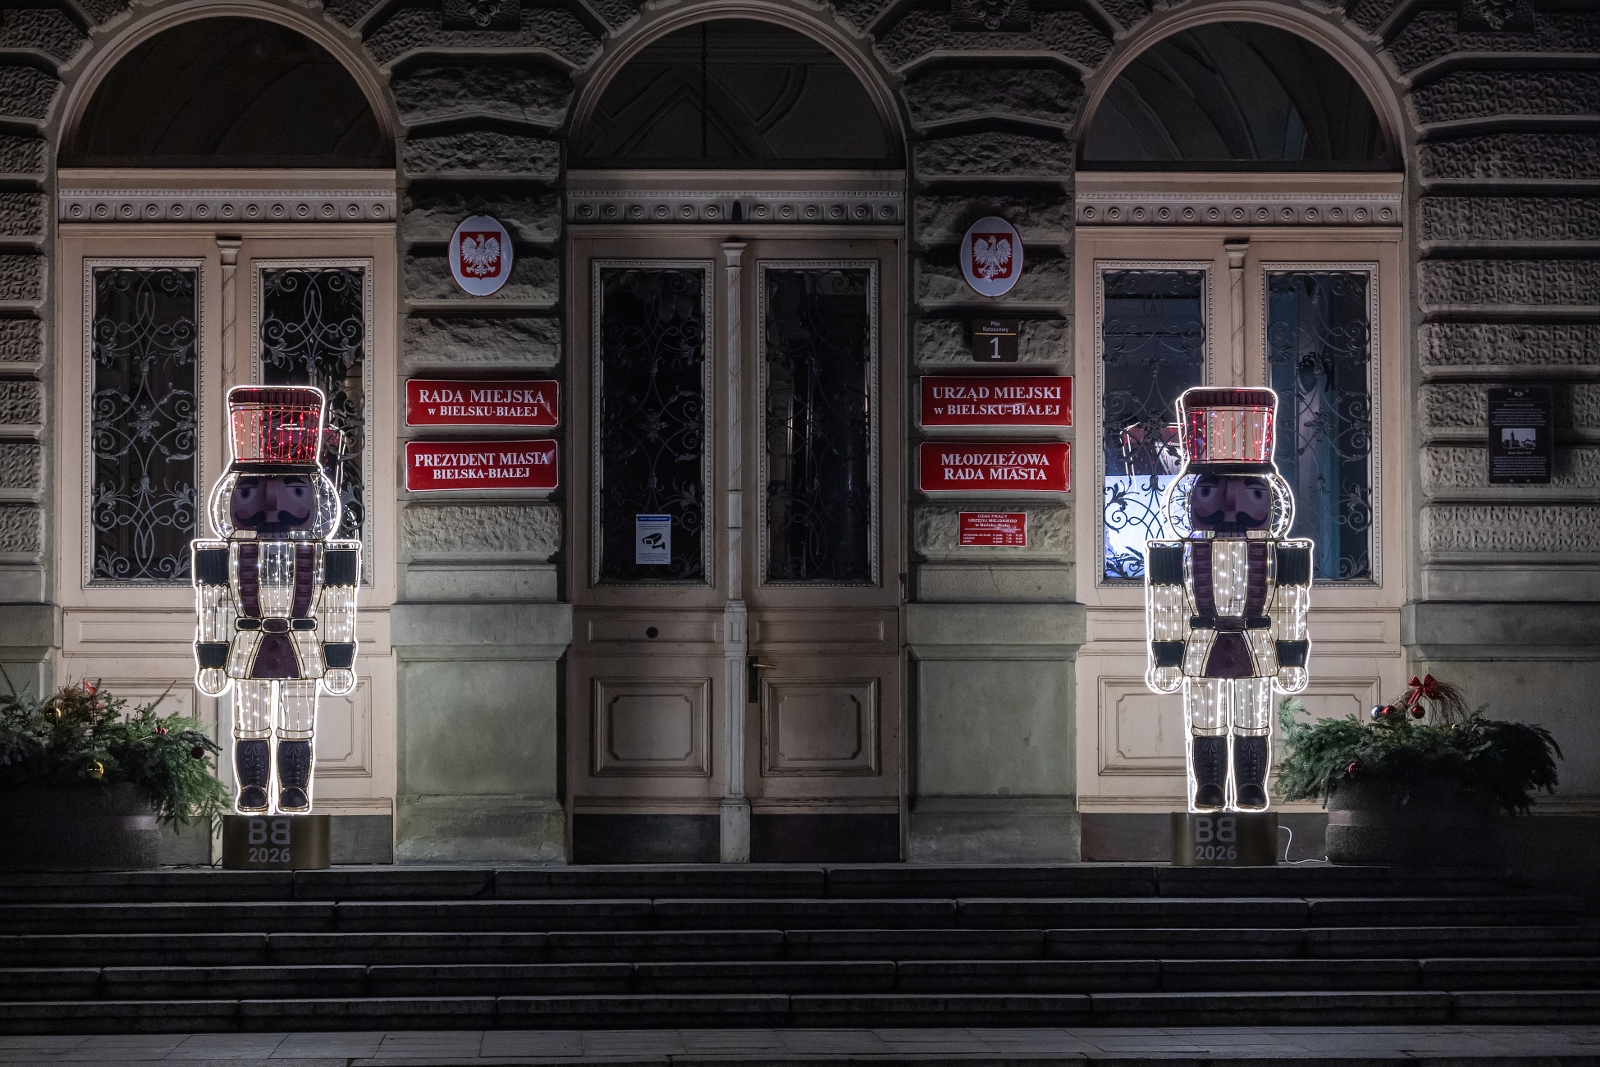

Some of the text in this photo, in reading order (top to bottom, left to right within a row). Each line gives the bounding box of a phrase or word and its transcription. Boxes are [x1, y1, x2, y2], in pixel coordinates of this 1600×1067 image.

[990, 337, 1001, 359] 1
[419, 389, 545, 404] RADA MIEJSKA
[932, 386, 1061, 402] URZĄD MIEJSKI
[439, 405, 538, 417] BIELSKU-BIAŁEJ
[933, 404, 1060, 416] w BIELSKU-BIAŁEJ
[414, 451, 550, 467] PREZYDENT MIASTA
[940, 451, 1050, 466] MŁODZIEŻOWA
[432, 467, 530, 480] BIELSKA-BIAŁEJ
[943, 468, 1048, 481] RADA MIASTA
[248, 847, 291, 863] 2026
[1195, 845, 1237, 860] 2026
